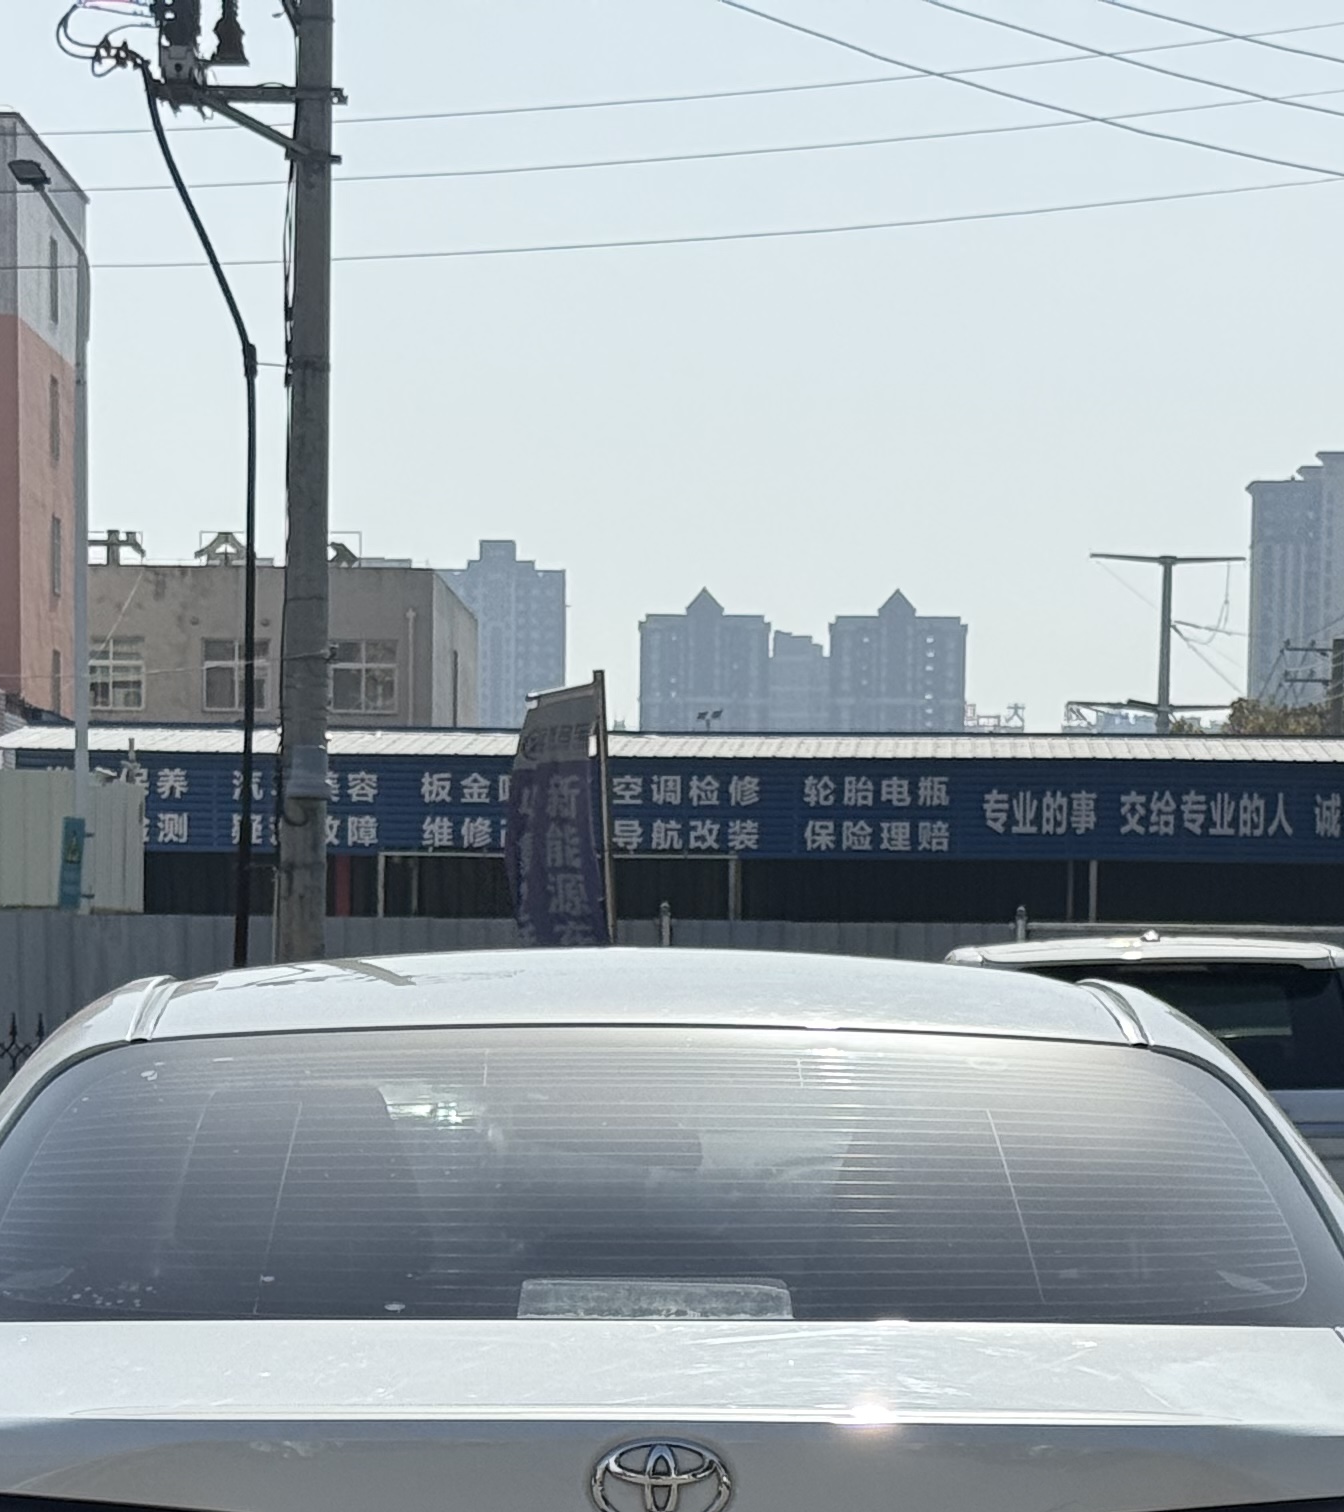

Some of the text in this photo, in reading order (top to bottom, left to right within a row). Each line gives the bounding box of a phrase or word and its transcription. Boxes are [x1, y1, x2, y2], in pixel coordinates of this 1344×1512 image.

[231, 770, 379, 803] 汽容
[612, 775, 761, 807] 空调检修
[803, 776, 950, 807] 轮胎电瓶
[143, 812, 950, 852] 测 疑障 维修 导航改装 保险理赔
[983, 789, 1098, 835] 专业的事
[1119, 790, 1294, 837] 交给专业的人
